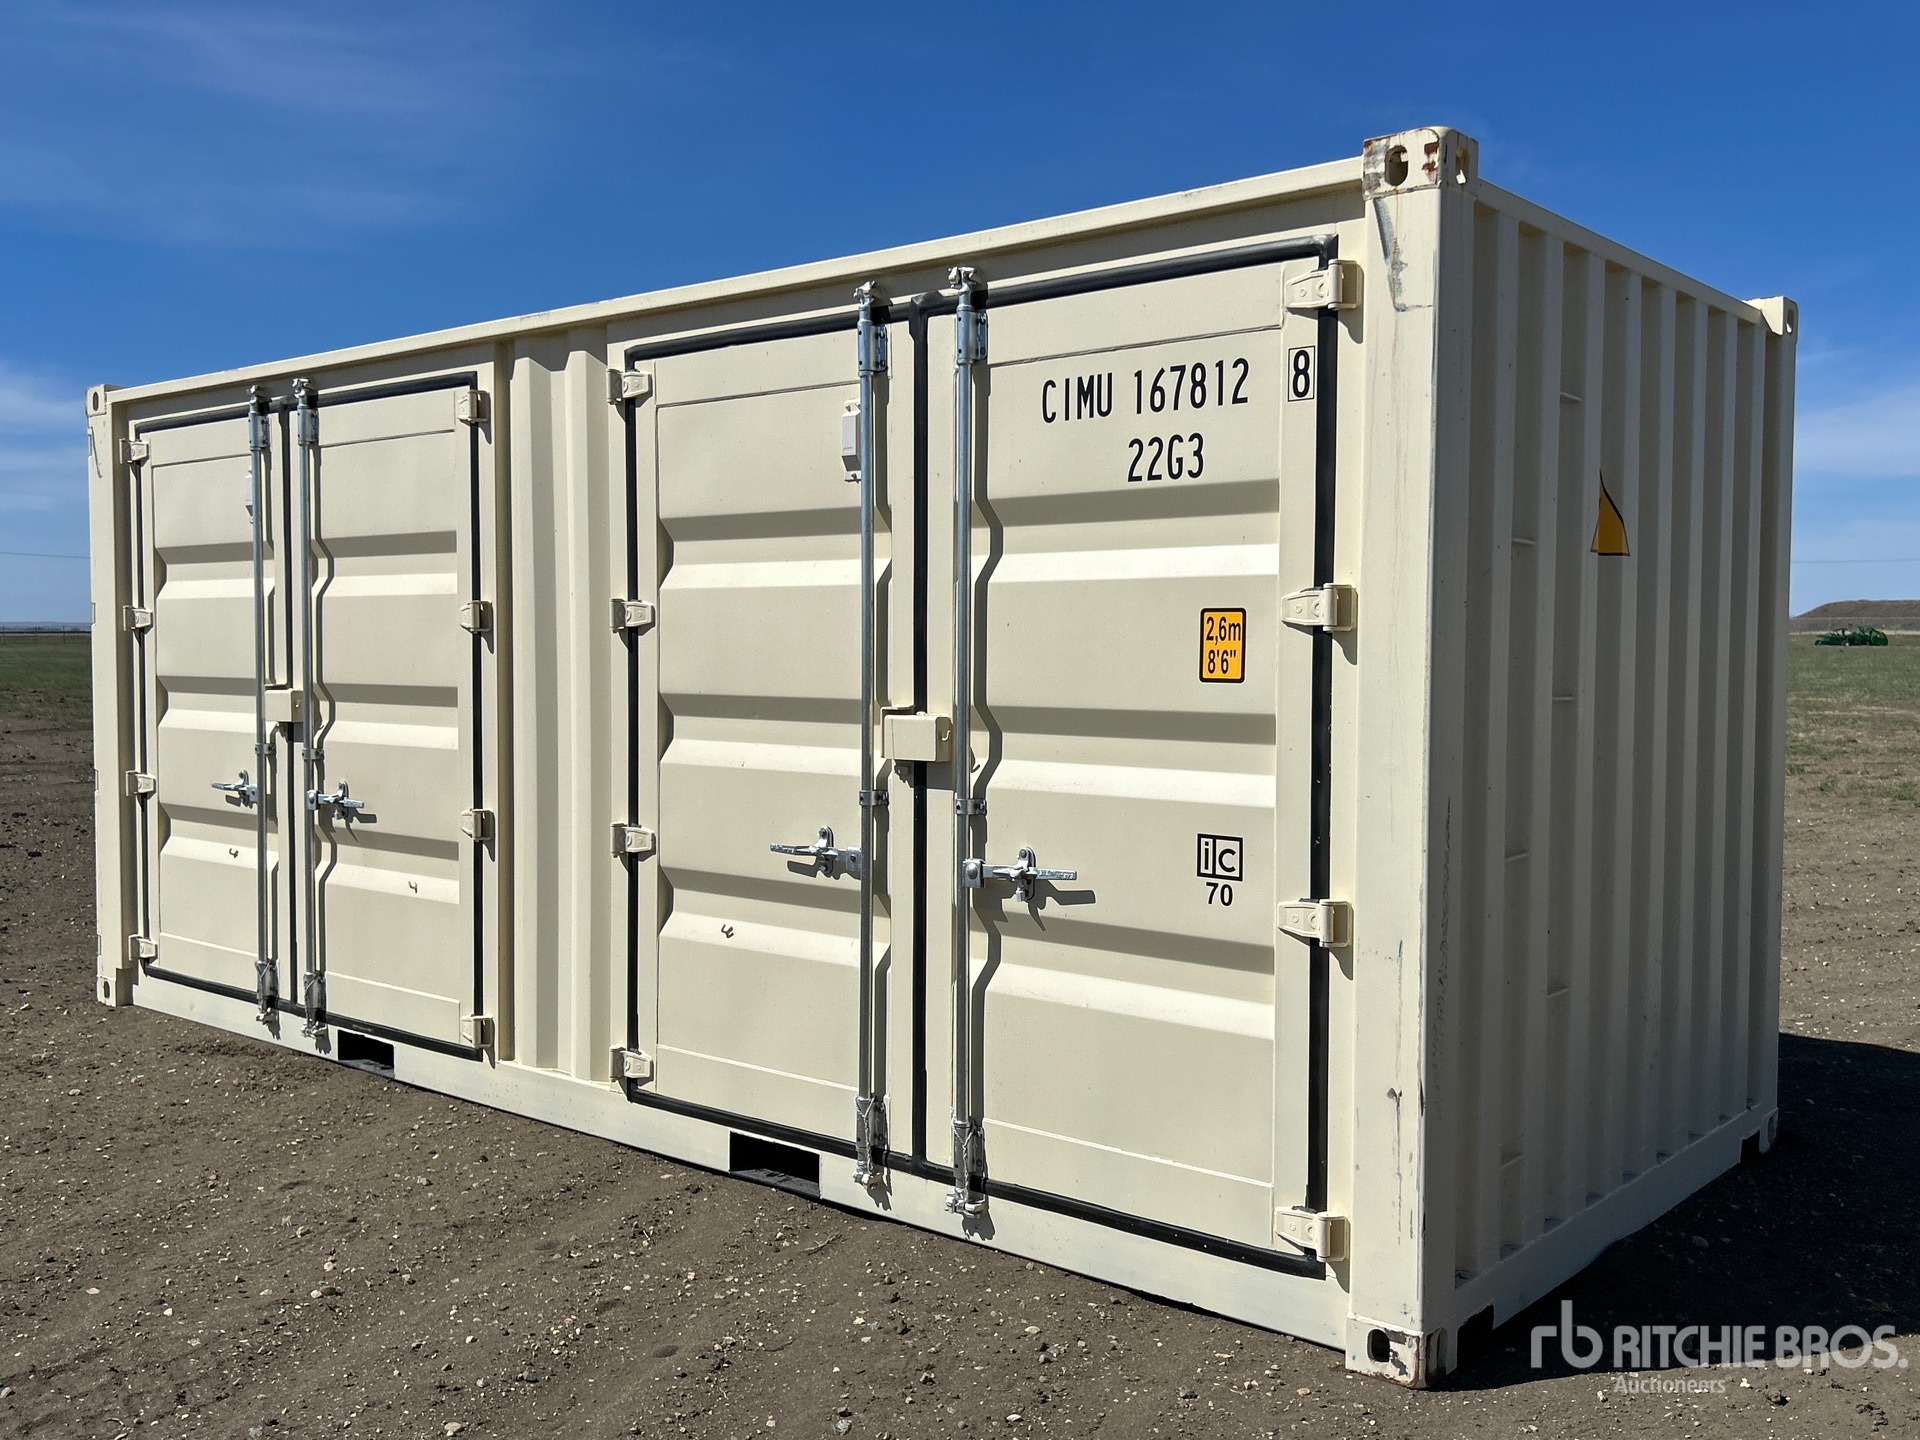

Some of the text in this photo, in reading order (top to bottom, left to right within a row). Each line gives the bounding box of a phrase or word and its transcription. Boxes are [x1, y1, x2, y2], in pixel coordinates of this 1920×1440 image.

[1042, 349, 1311, 424] CIMU 167812 8
[1127, 432, 1204, 483] 22G3
[1205, 616, 1241, 646] 2,6m
[1207, 649, 1237, 675] 8'6"
[1205, 881, 1233, 907] 70
